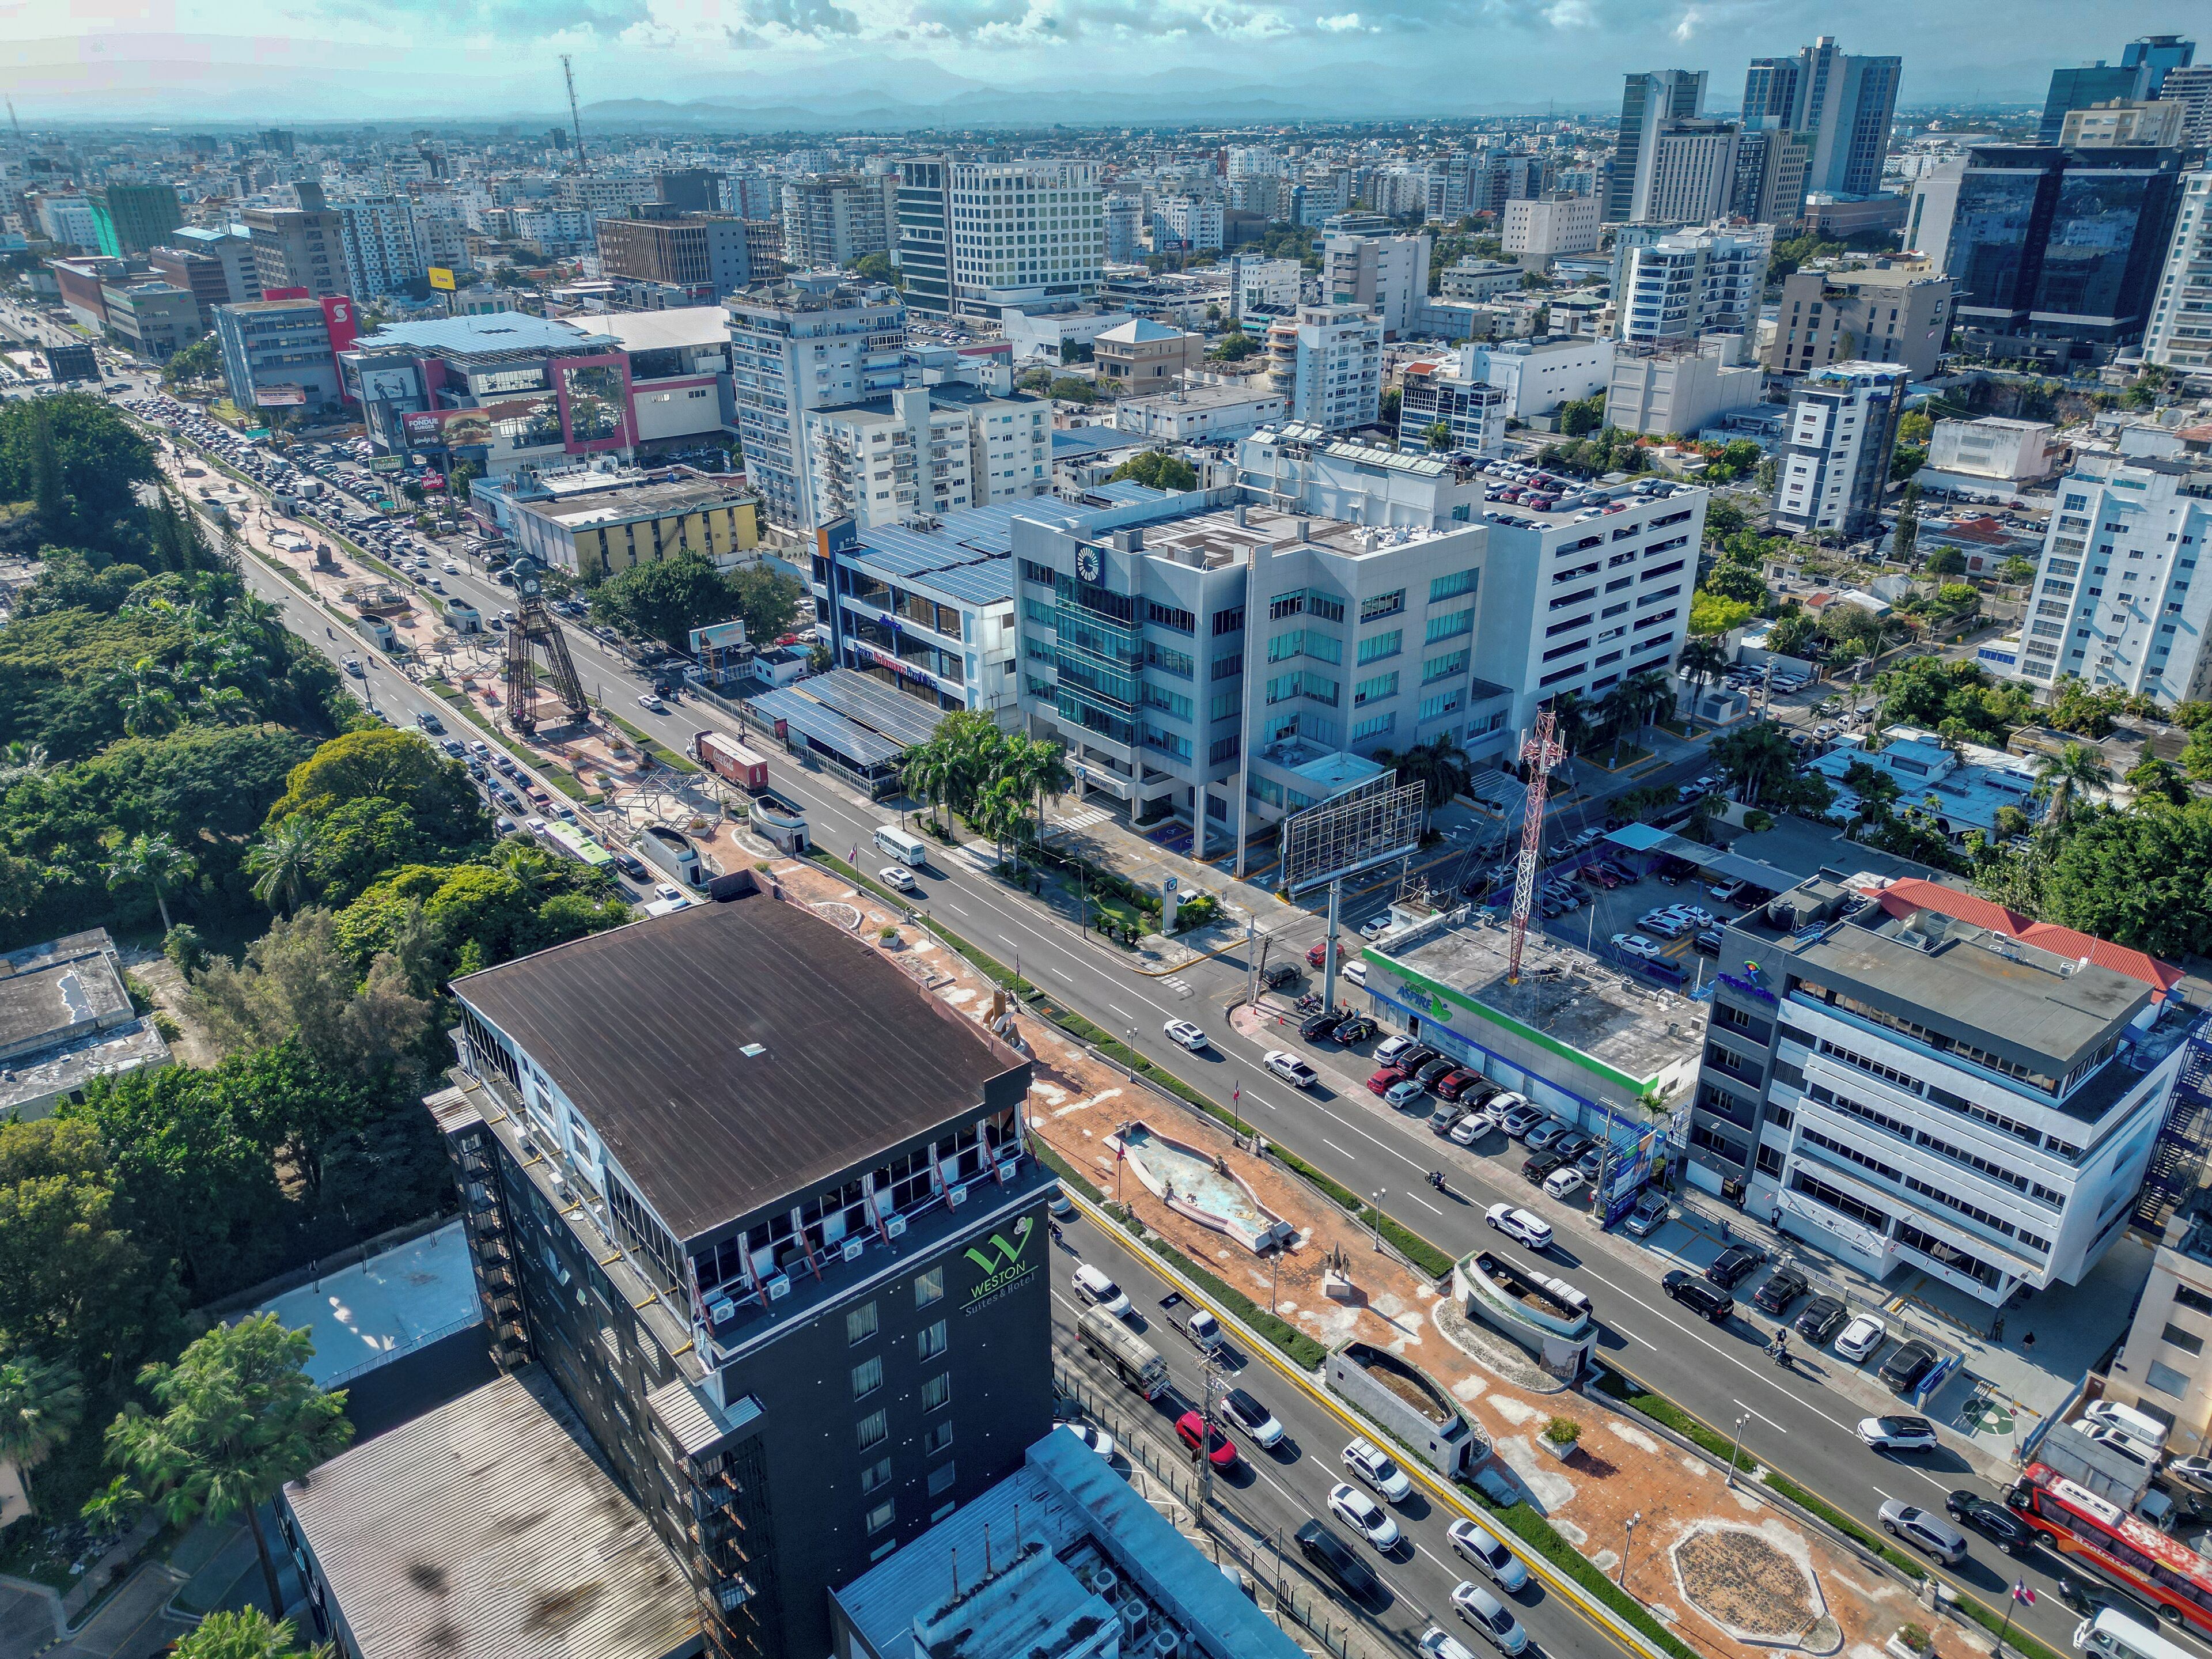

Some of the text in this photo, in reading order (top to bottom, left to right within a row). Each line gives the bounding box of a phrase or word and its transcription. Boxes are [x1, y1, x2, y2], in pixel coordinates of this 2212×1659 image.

[408, 418, 439, 427] FONDUE
[374, 460, 401, 470] Nacional
[423, 478, 443, 487] Wendy's
[1085, 774, 1107, 789] POPULAR
[1396, 986, 1433, 1010] ASPIRE
[971, 1260, 1025, 1298] WESTON
[965, 1272, 1035, 1317] Suites & Hotel
